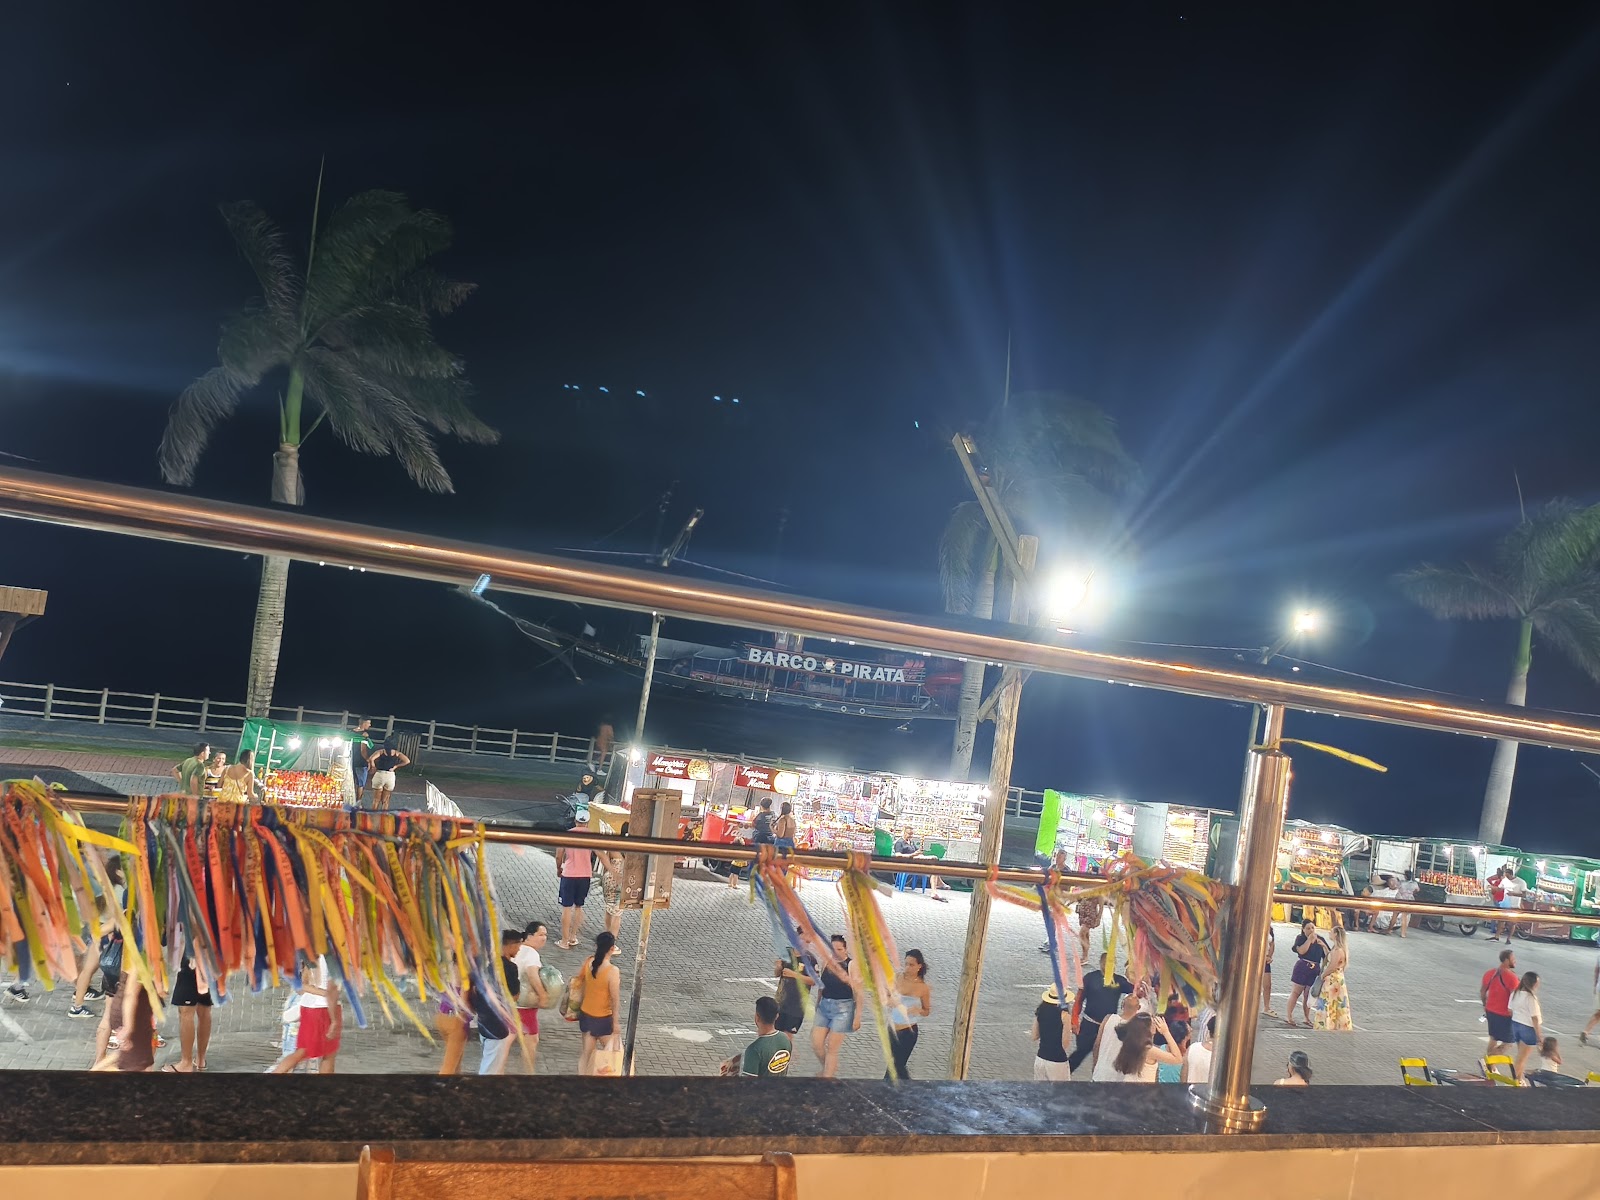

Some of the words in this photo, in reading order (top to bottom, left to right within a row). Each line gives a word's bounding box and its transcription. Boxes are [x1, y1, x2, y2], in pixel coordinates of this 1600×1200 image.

[749, 647, 817, 671] BARCO
[841, 662, 905, 683] PIRATA
[741, 766, 769, 780] Tapioca
